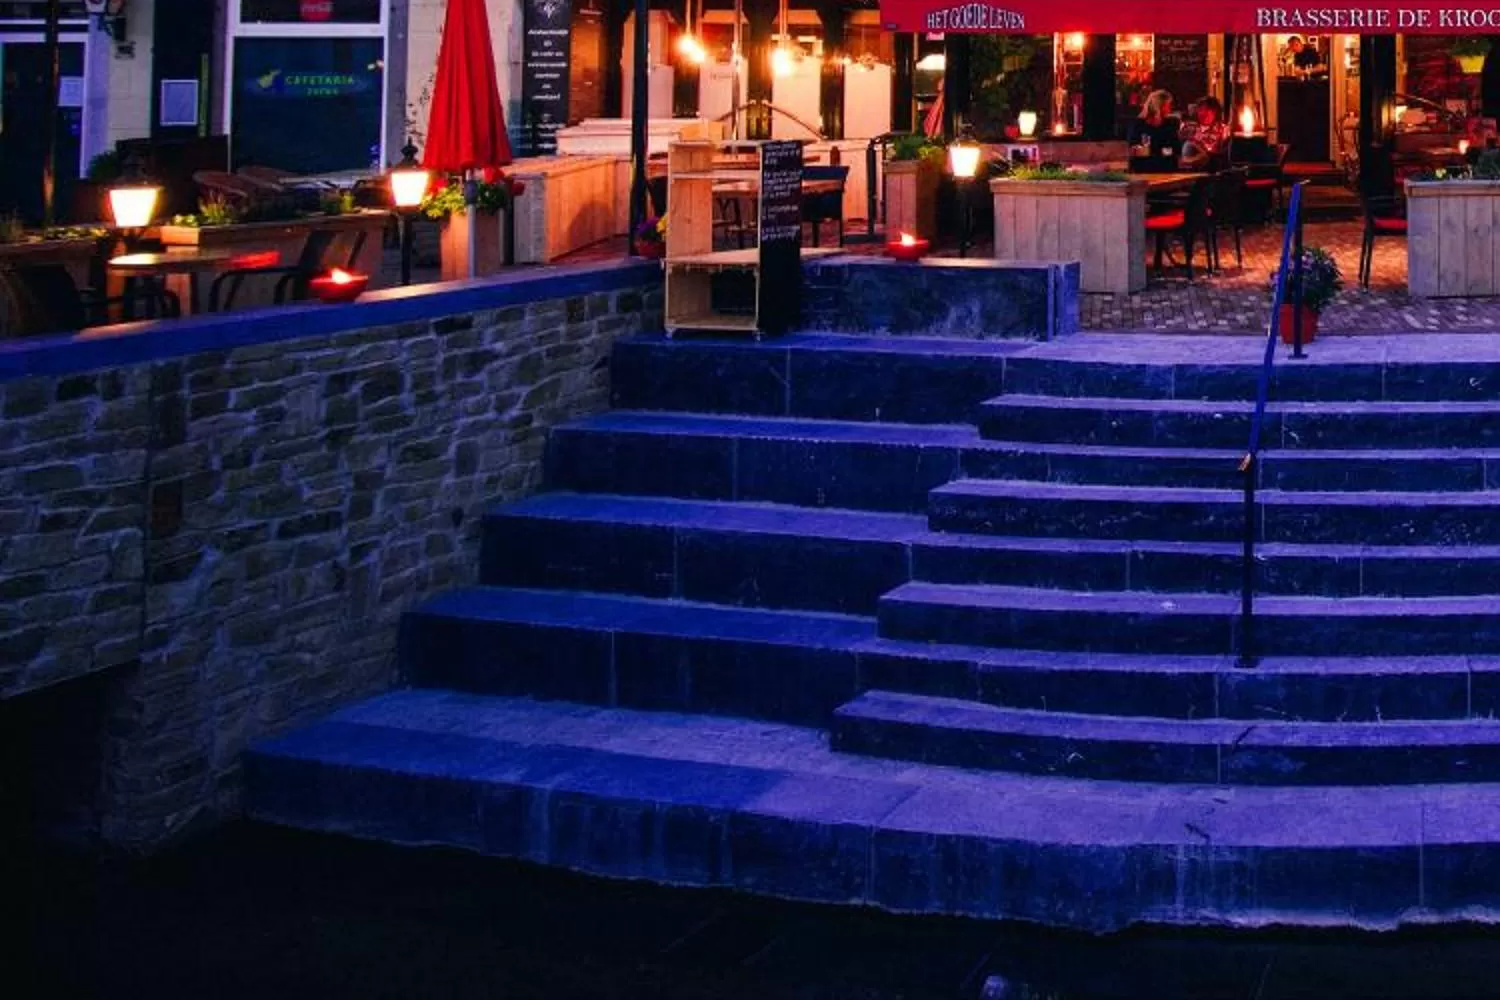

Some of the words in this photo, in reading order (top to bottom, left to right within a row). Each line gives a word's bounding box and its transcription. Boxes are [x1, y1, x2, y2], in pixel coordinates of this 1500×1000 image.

[927, 8, 949, 30] HET
[950, 2, 988, 30] GOEDE
[989, 8, 1025, 30] LEVEN
[1256, 7, 1391, 28] BRASSERIE
[1399, 8, 1431, 28] DE
